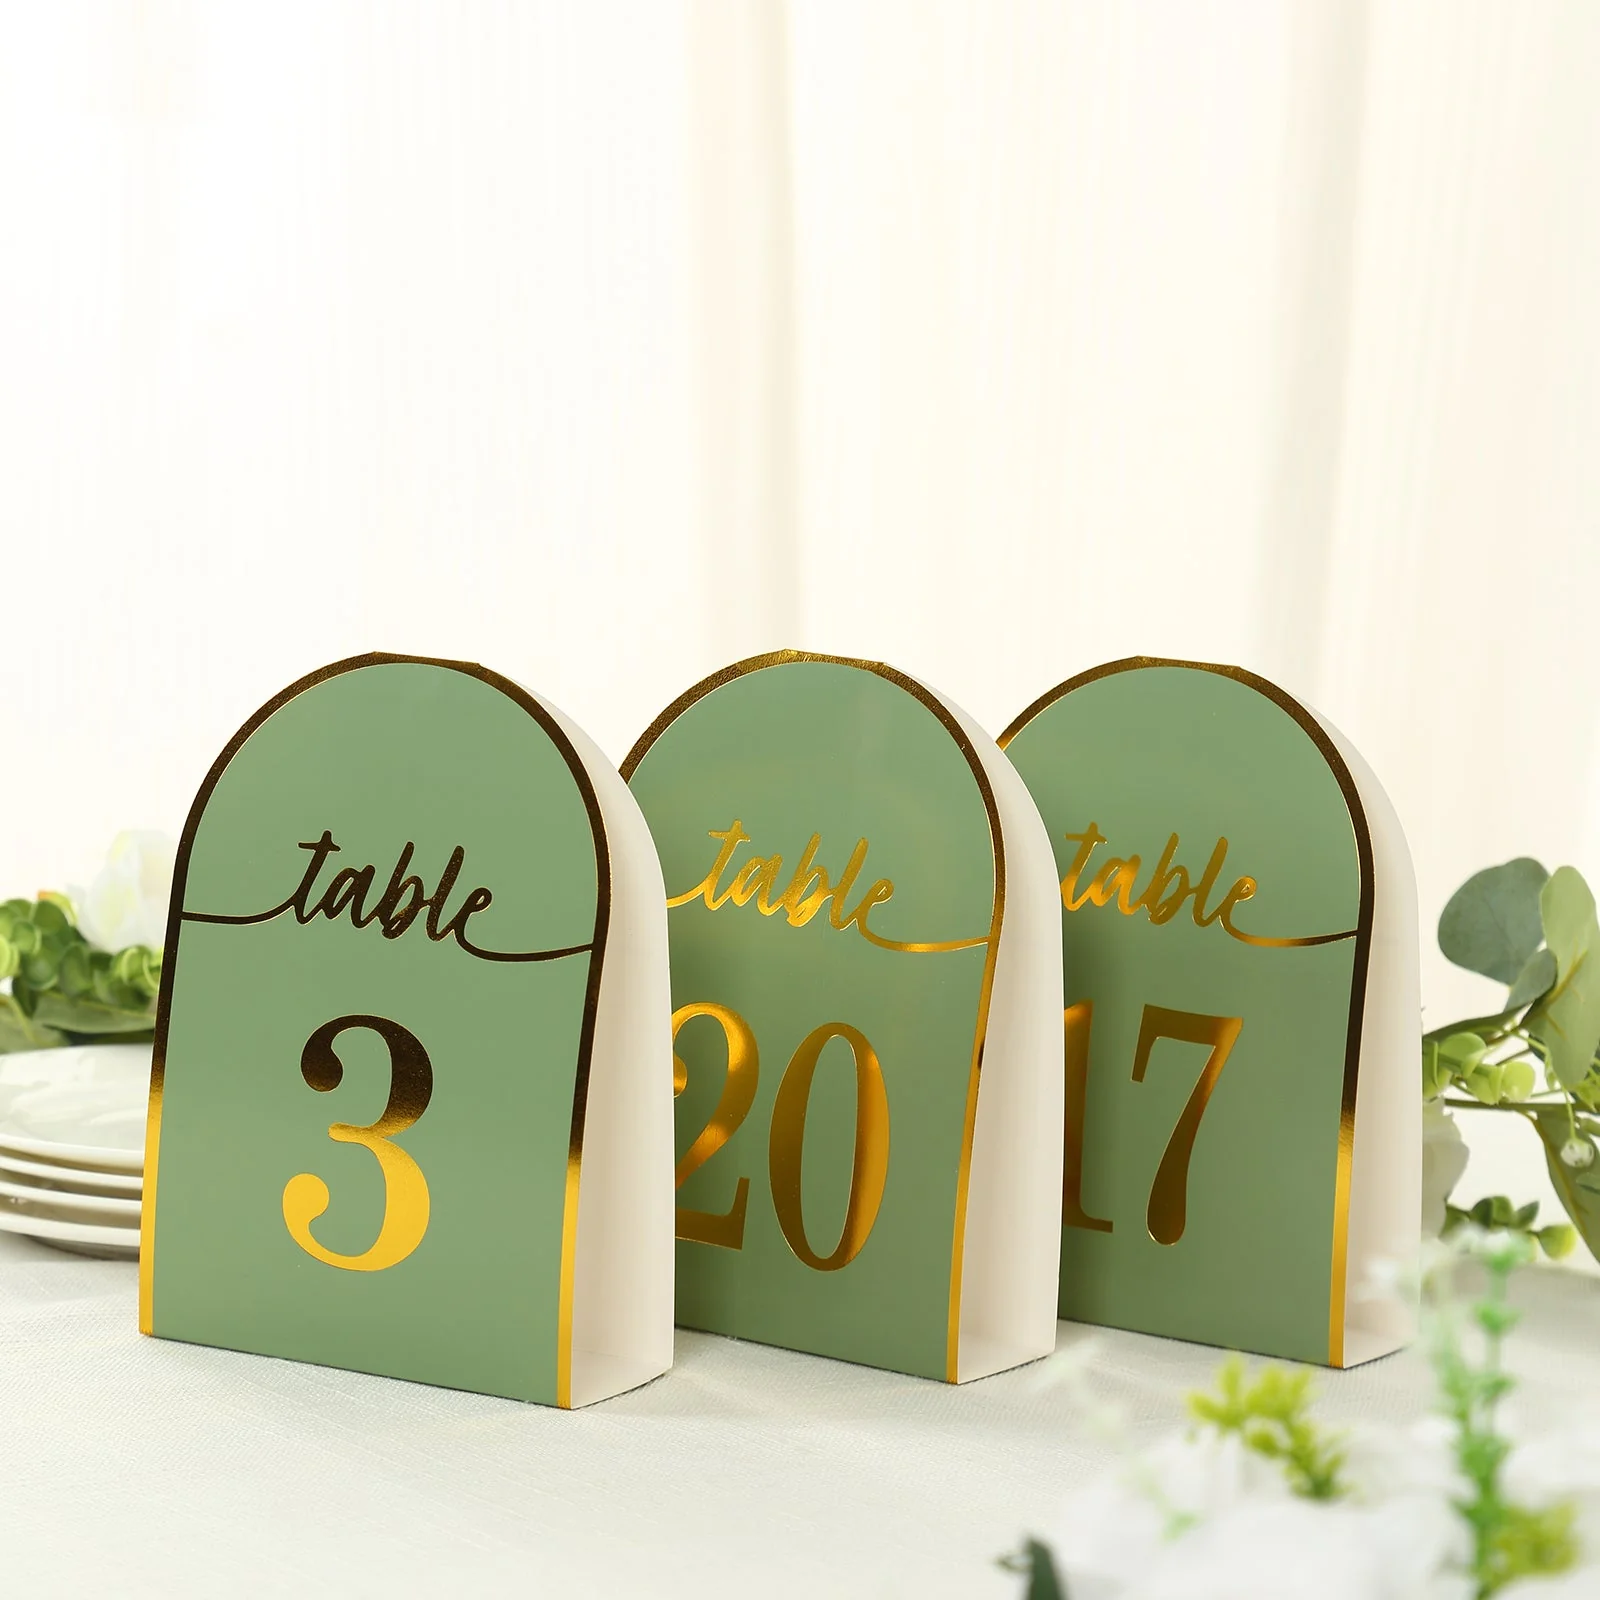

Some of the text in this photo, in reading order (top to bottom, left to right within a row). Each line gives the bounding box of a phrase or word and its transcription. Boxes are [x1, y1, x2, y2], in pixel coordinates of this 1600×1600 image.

[291, 829, 592, 962] table
[697, 819, 989, 953] table
[1061, 821, 1357, 948] table
[282, 1013, 434, 1272] 3
[671, 1001, 891, 1272] 20
[1063, 998, 1244, 1246] 17
